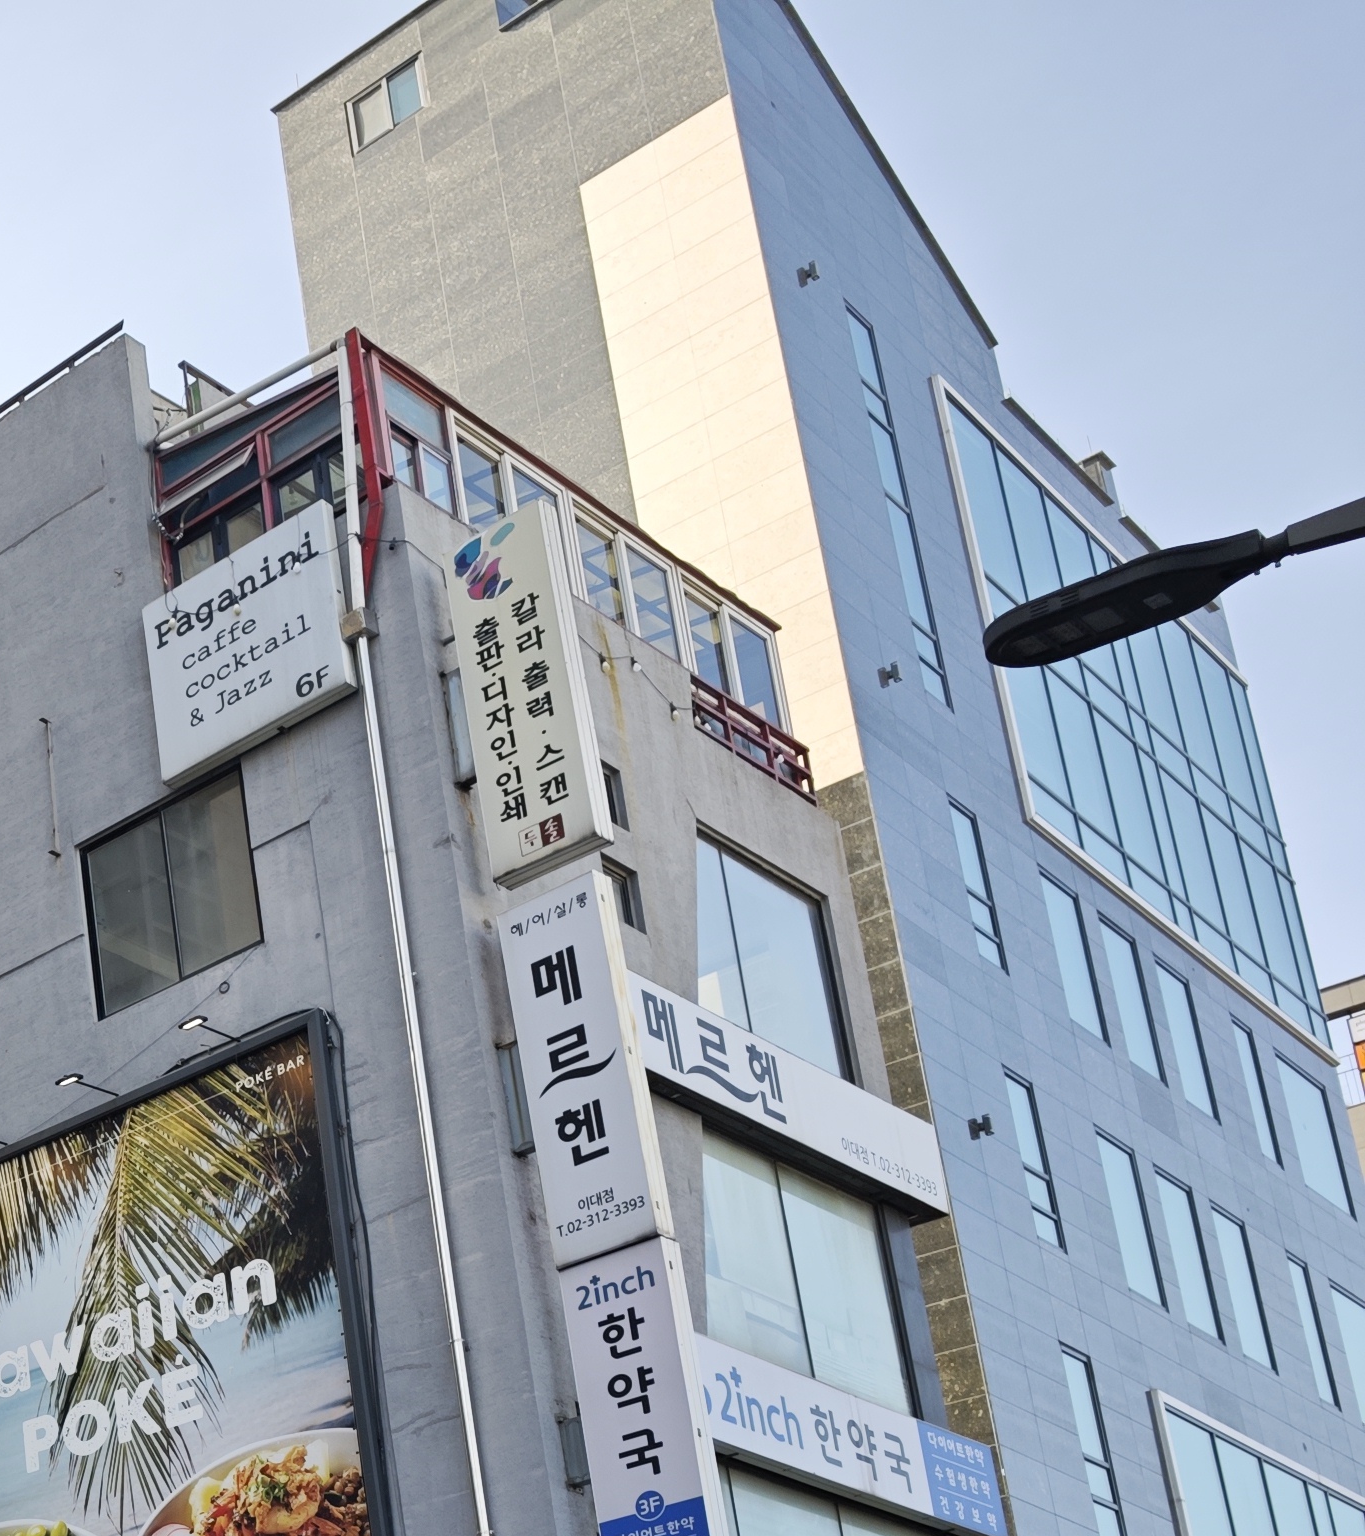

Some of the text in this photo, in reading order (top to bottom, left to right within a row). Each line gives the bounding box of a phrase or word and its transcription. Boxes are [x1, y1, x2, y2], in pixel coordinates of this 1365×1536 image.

[182, 618, 256, 670] caffe
[186, 613, 311, 698] cocktail
[190, 669, 273, 727] & Jazz
[295, 664, 329, 698] 6F
[277, 1053, 306, 1081] BAR
[530, 945, 617, 1167] 메르헨
[640, 989, 787, 1125] 메르헨
[841, 1137, 870, 1166] 이대점
[577, 1187, 615, 1212] 이대점
[576, 1265, 655, 1311] 2inch
[597, 1307, 664, 1475] 한약국
[716, 1364, 913, 1494] 2inch 한약국
[927, 1431, 985, 1468] 다이어트한약
[638, 1495, 661, 1516] 3F
